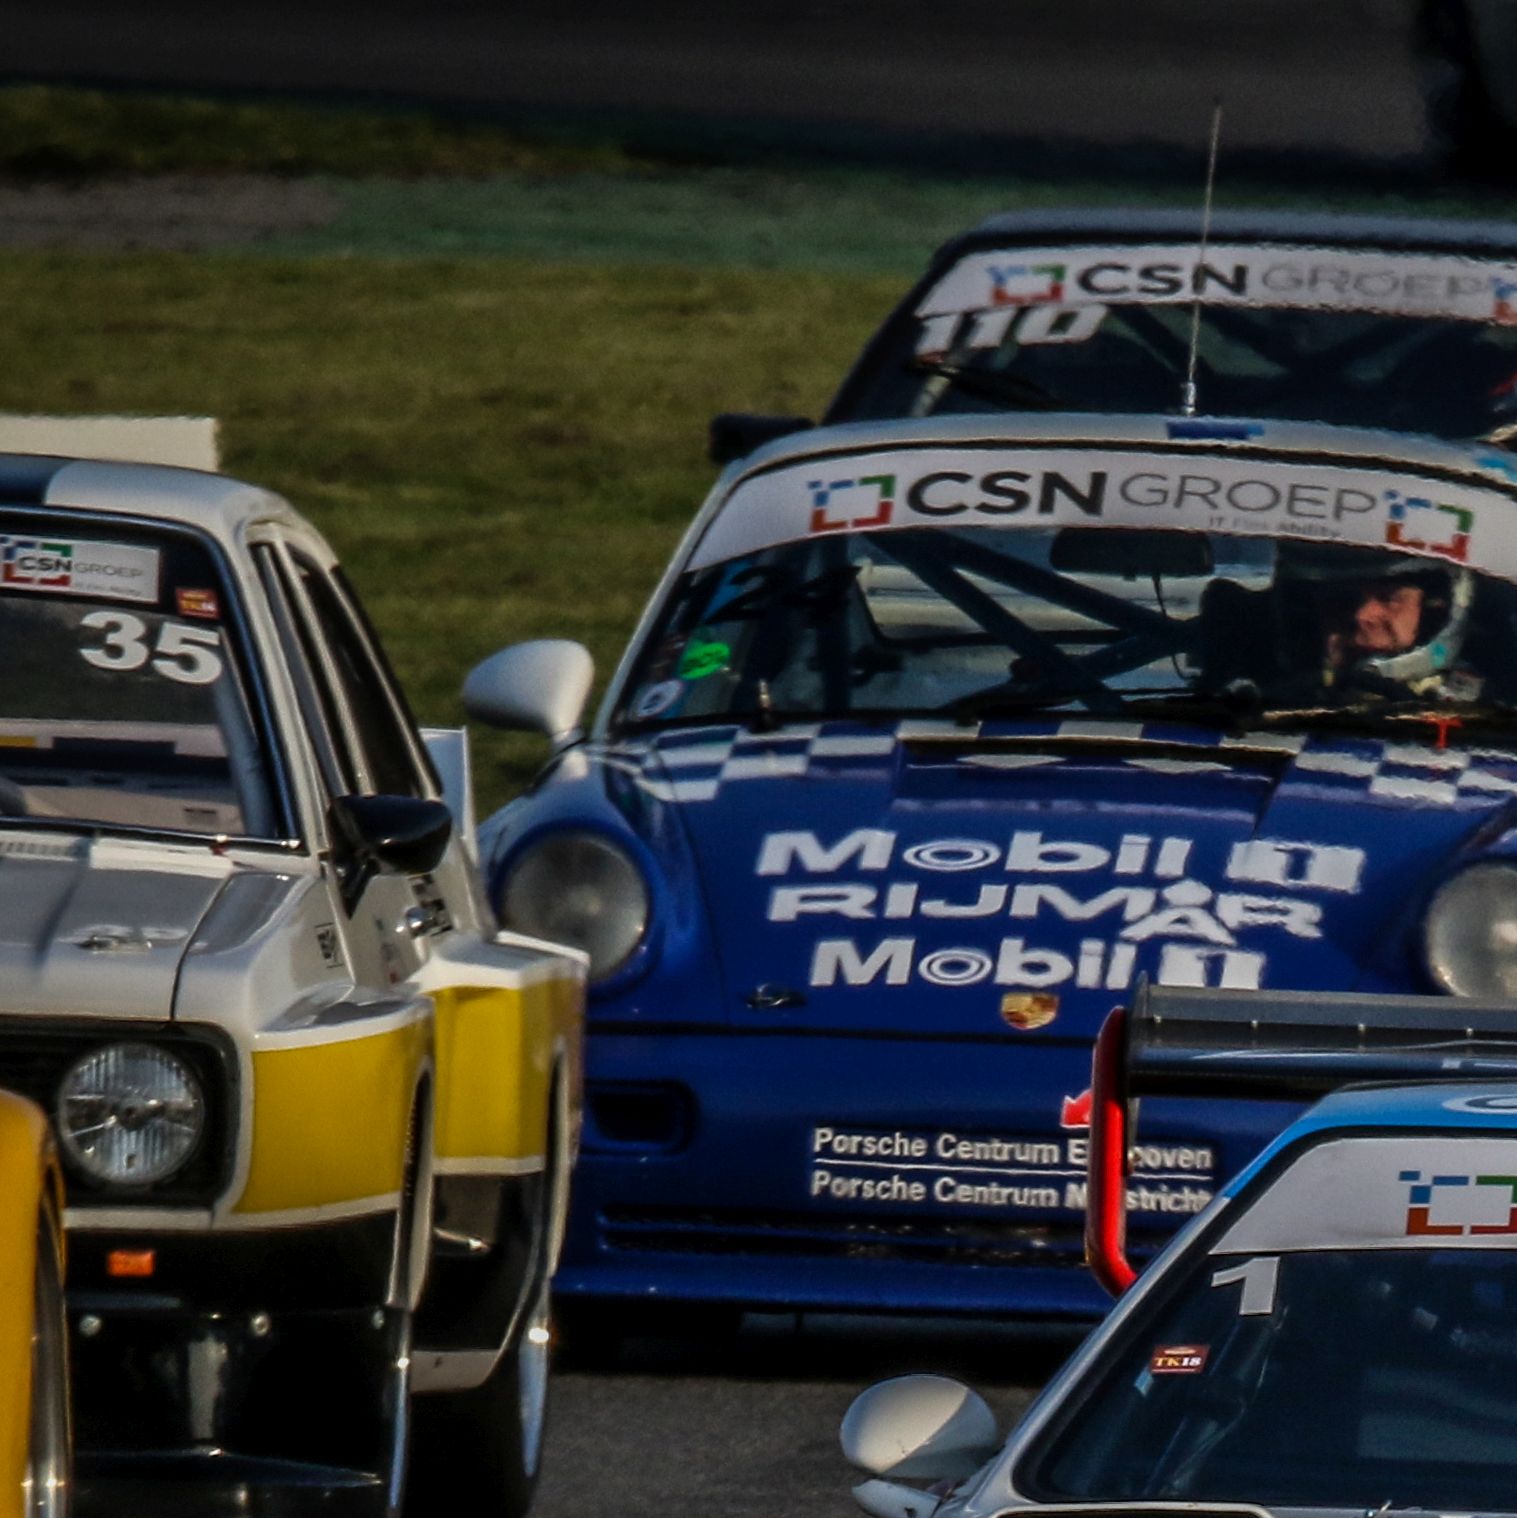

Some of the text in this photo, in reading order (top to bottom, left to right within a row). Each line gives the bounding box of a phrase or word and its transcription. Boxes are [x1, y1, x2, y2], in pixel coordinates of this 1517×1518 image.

[80, 610, 222, 685] 35
[755, 830, 1192, 877] Mobil
[809, 936, 1139, 990] Mobil
[812, 1127, 927, 1159] Porsche
[936, 1132, 1060, 1165] Centrum
[810, 1170, 926, 1203] Porsche
[933, 1176, 1059, 1208] Centrum
[1210, 1256, 1281, 1316] 1
